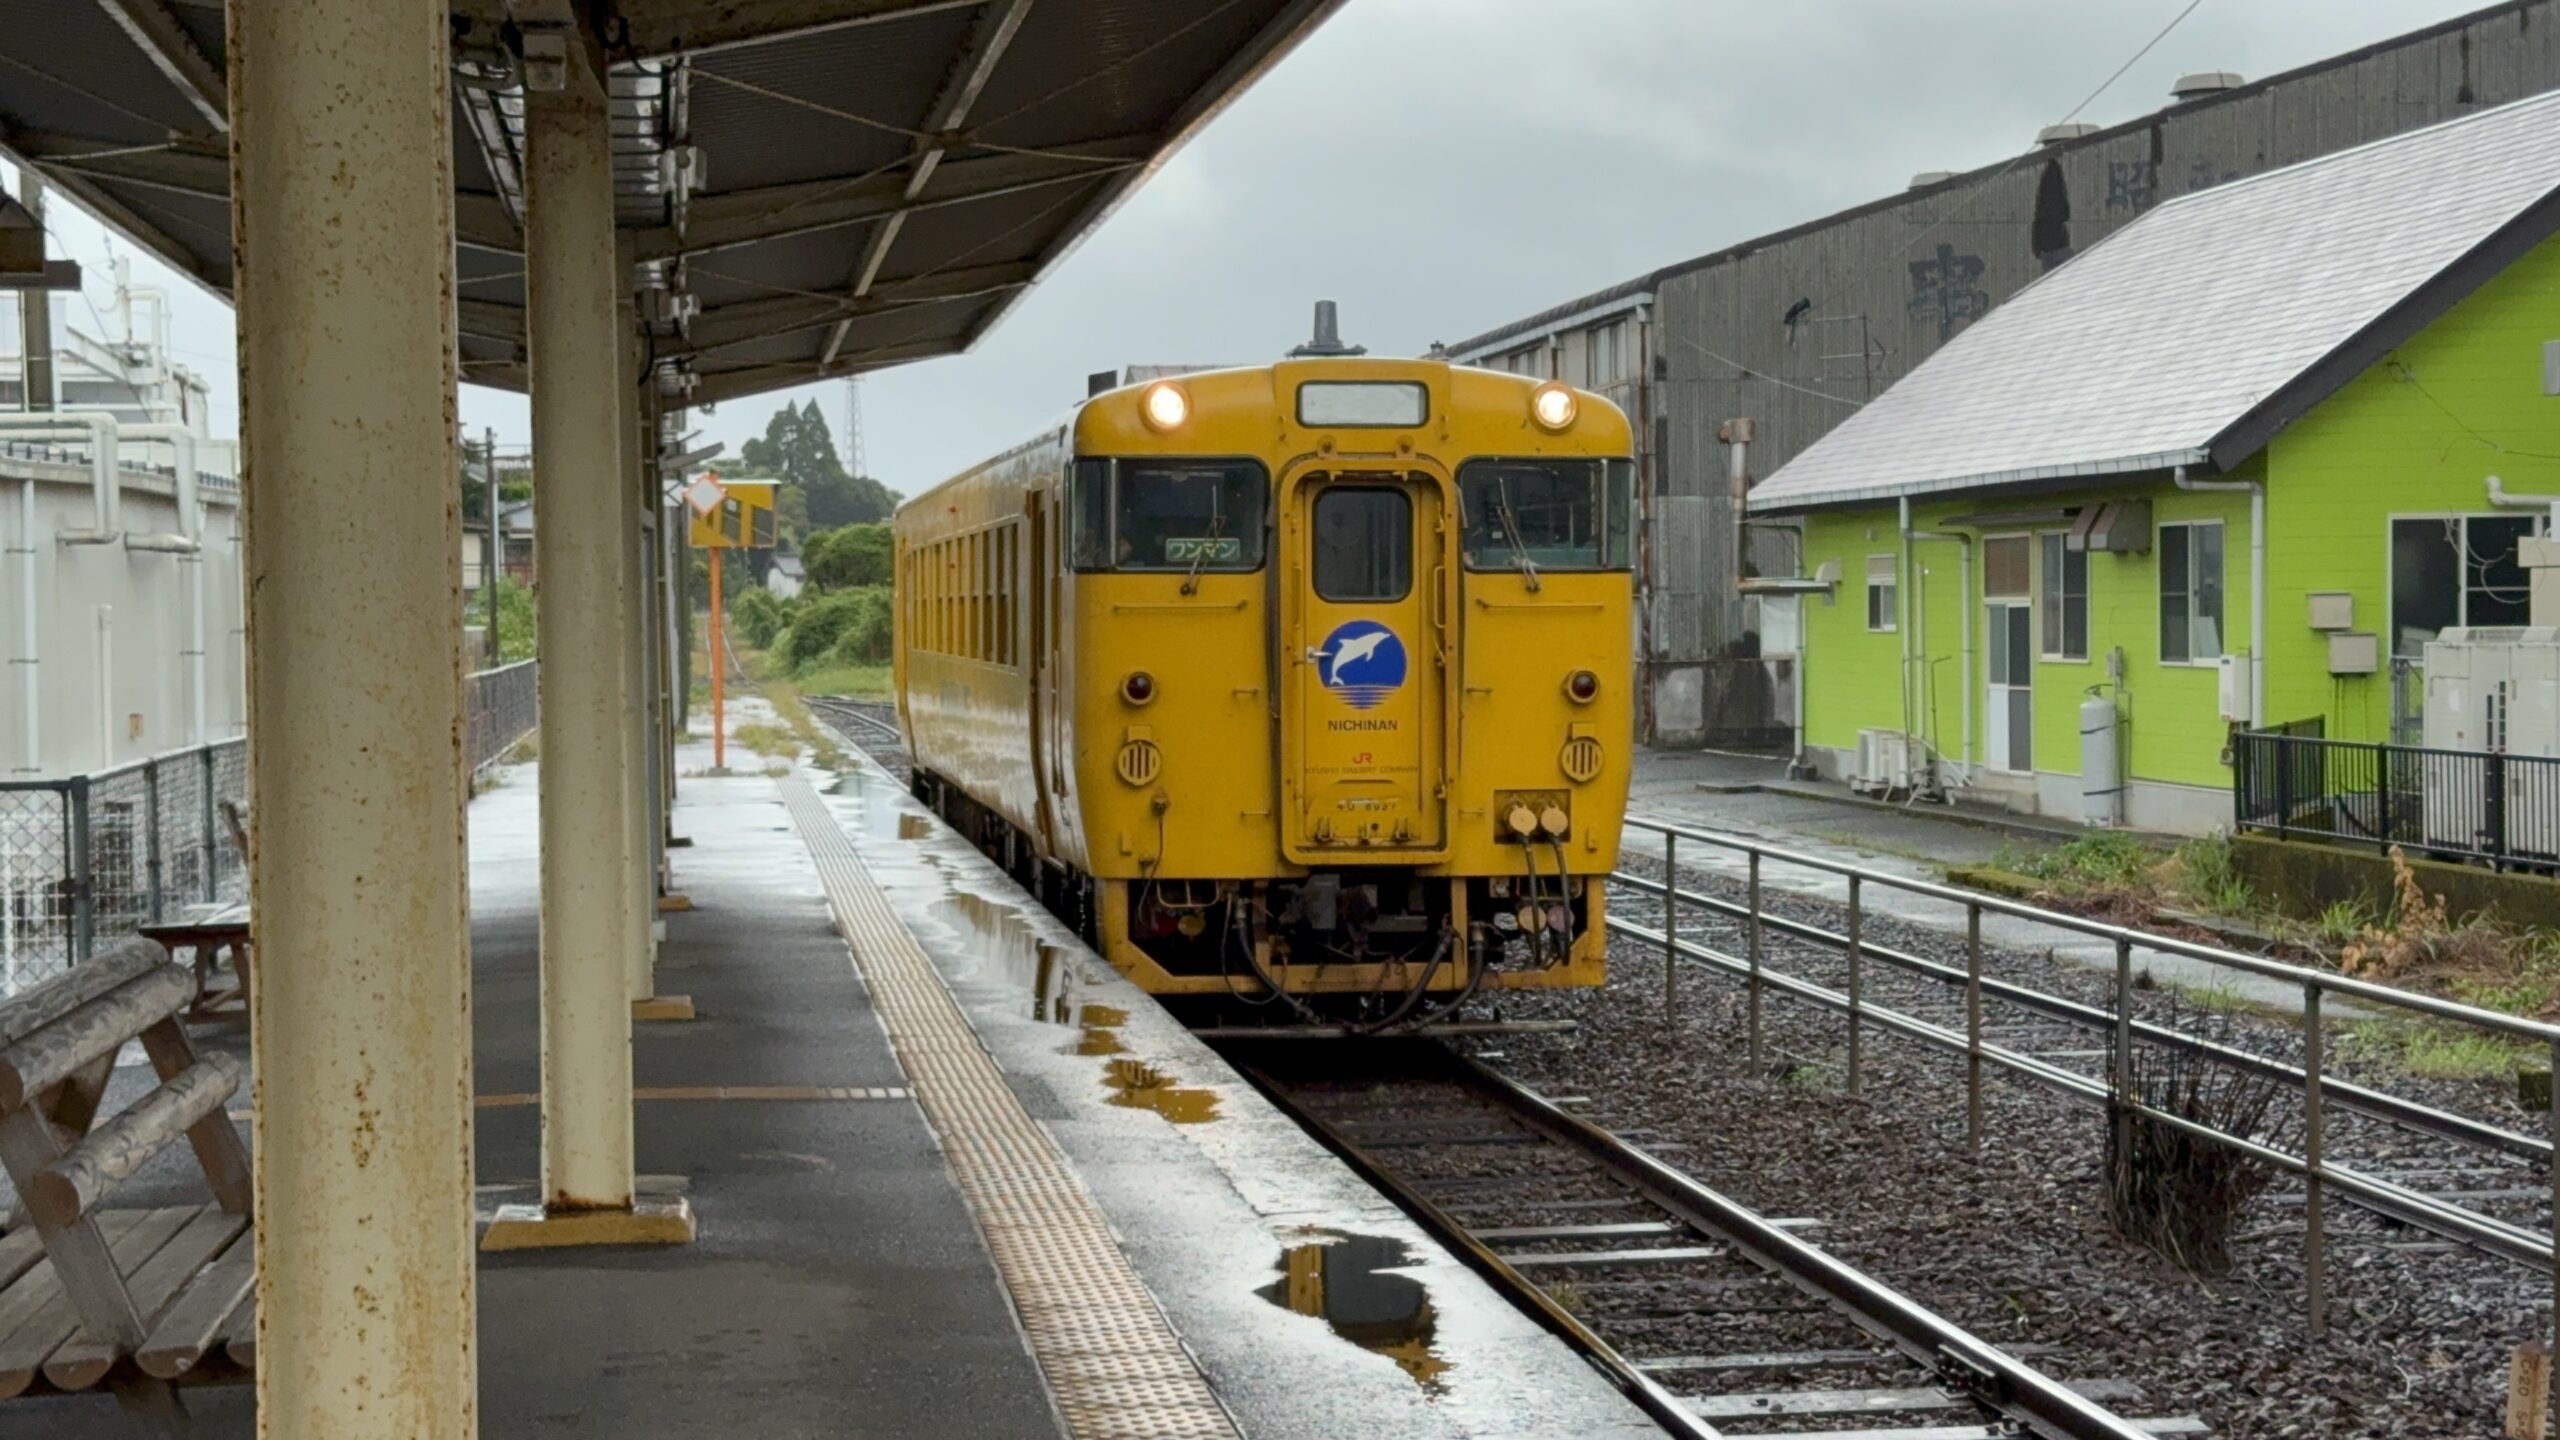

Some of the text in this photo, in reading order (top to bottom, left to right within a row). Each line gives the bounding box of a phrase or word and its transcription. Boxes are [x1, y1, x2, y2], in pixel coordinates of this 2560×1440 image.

[1169, 541, 1237, 559] ワンマン
[1328, 719, 1398, 731] NICHINAN
[1353, 752, 1373, 764] JR
